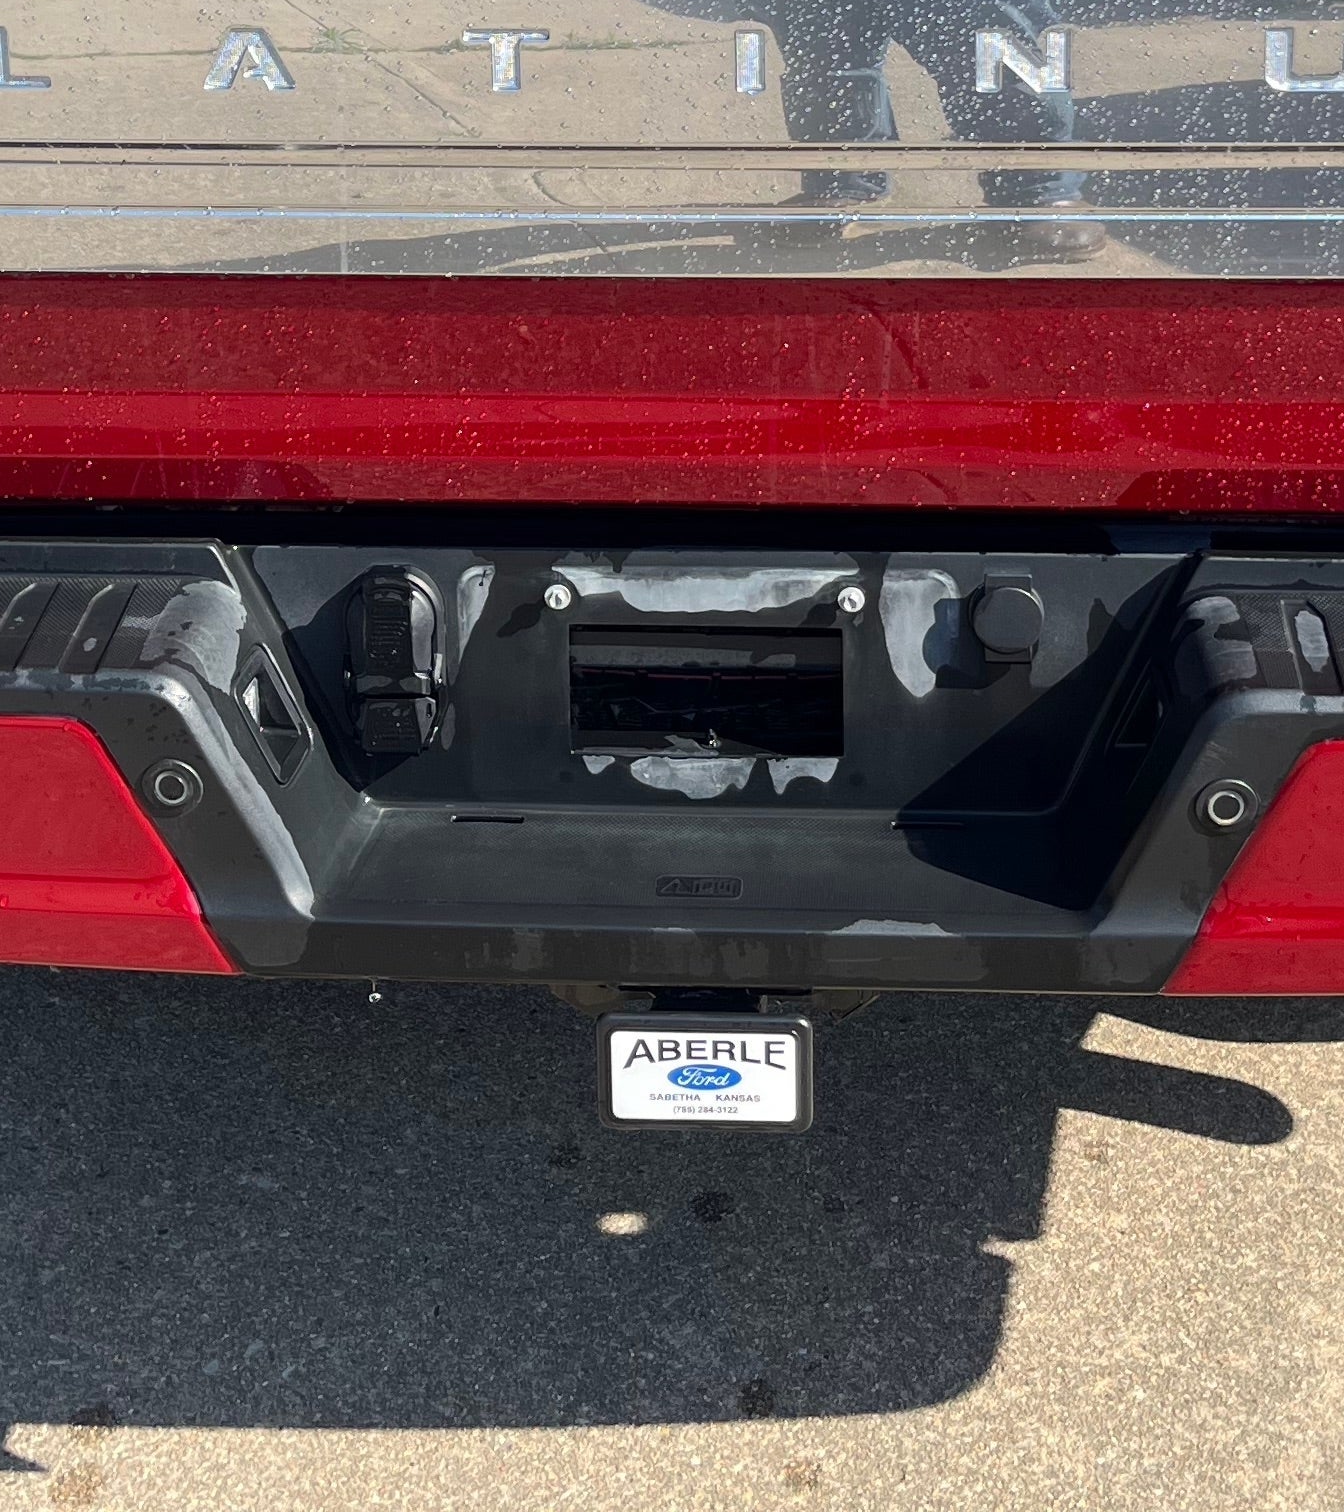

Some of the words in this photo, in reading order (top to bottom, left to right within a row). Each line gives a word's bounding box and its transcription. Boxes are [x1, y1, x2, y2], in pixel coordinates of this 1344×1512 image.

[623, 1039, 786, 1070] ABERLE
[677, 1066, 731, 1087] Ford
[649, 1093, 700, 1102] SABETHA
[716, 1094, 760, 1103] KANSAS
